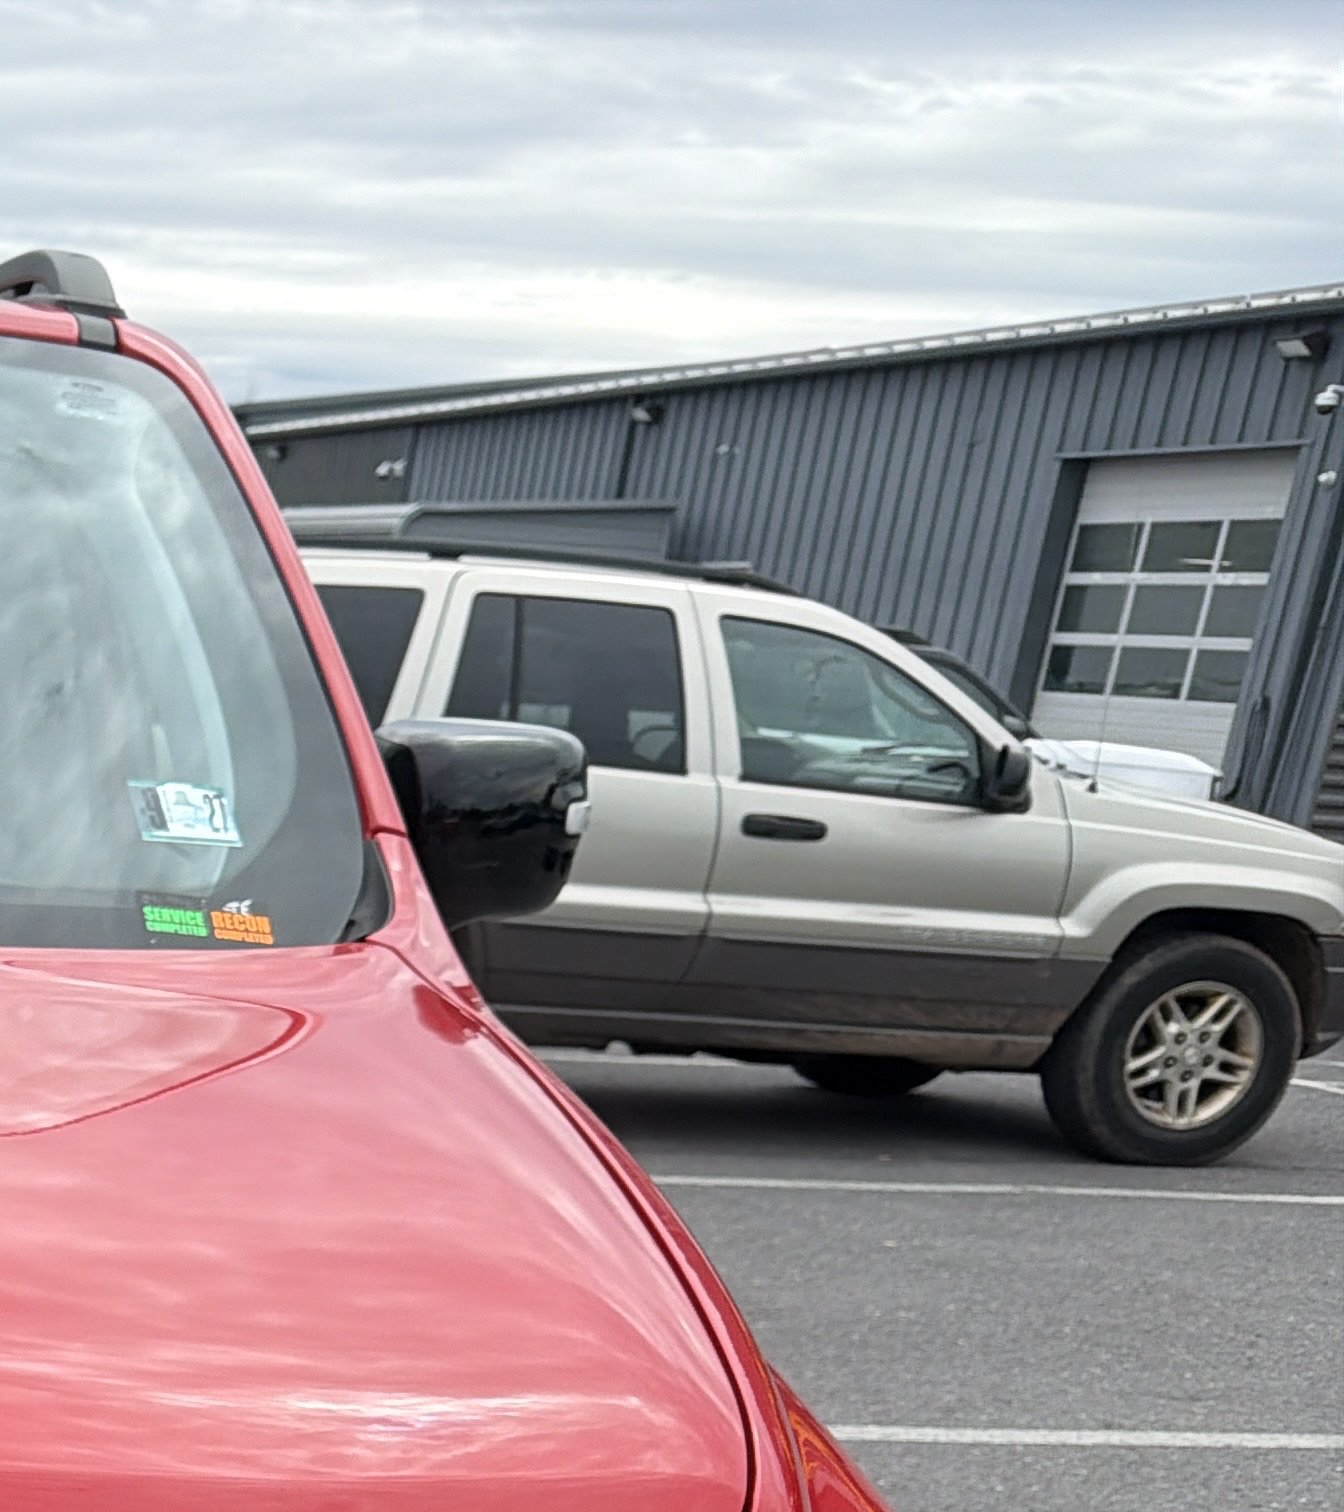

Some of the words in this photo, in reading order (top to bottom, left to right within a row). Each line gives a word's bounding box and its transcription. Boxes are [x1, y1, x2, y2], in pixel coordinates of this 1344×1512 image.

[143, 905, 205, 926] SERVICE
[210, 911, 272, 934] RECON
[145, 921, 208, 937] COMPLETED
[214, 928, 274, 945] COMPLETED
